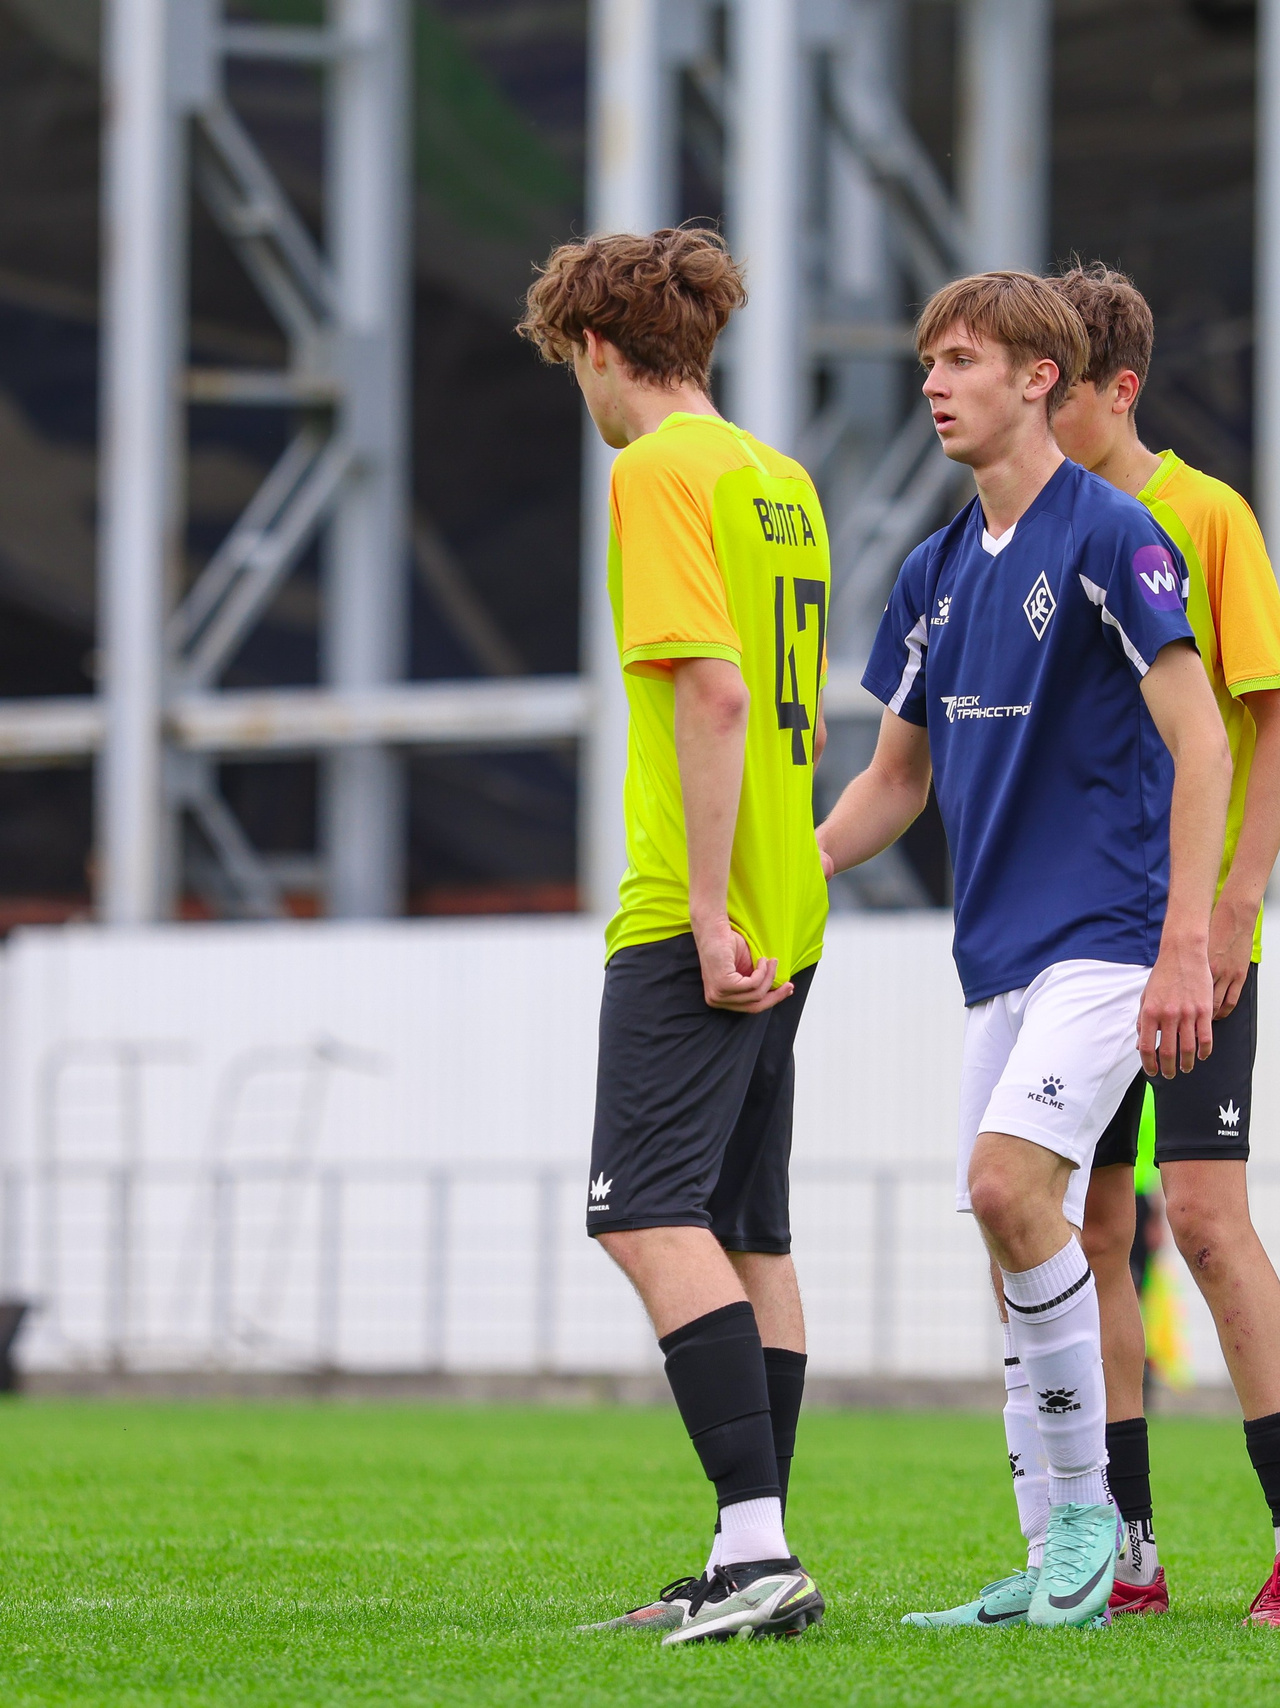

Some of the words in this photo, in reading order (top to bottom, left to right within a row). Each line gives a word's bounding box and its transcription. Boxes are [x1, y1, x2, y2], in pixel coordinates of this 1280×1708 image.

[753, 497, 817, 547] ВОЛГА
[775, 575, 826, 766] 47
[957, 695, 981, 708] ДСК
[1027, 1091, 1065, 1111] KELME
[1038, 1404, 1081, 1414] KELME
